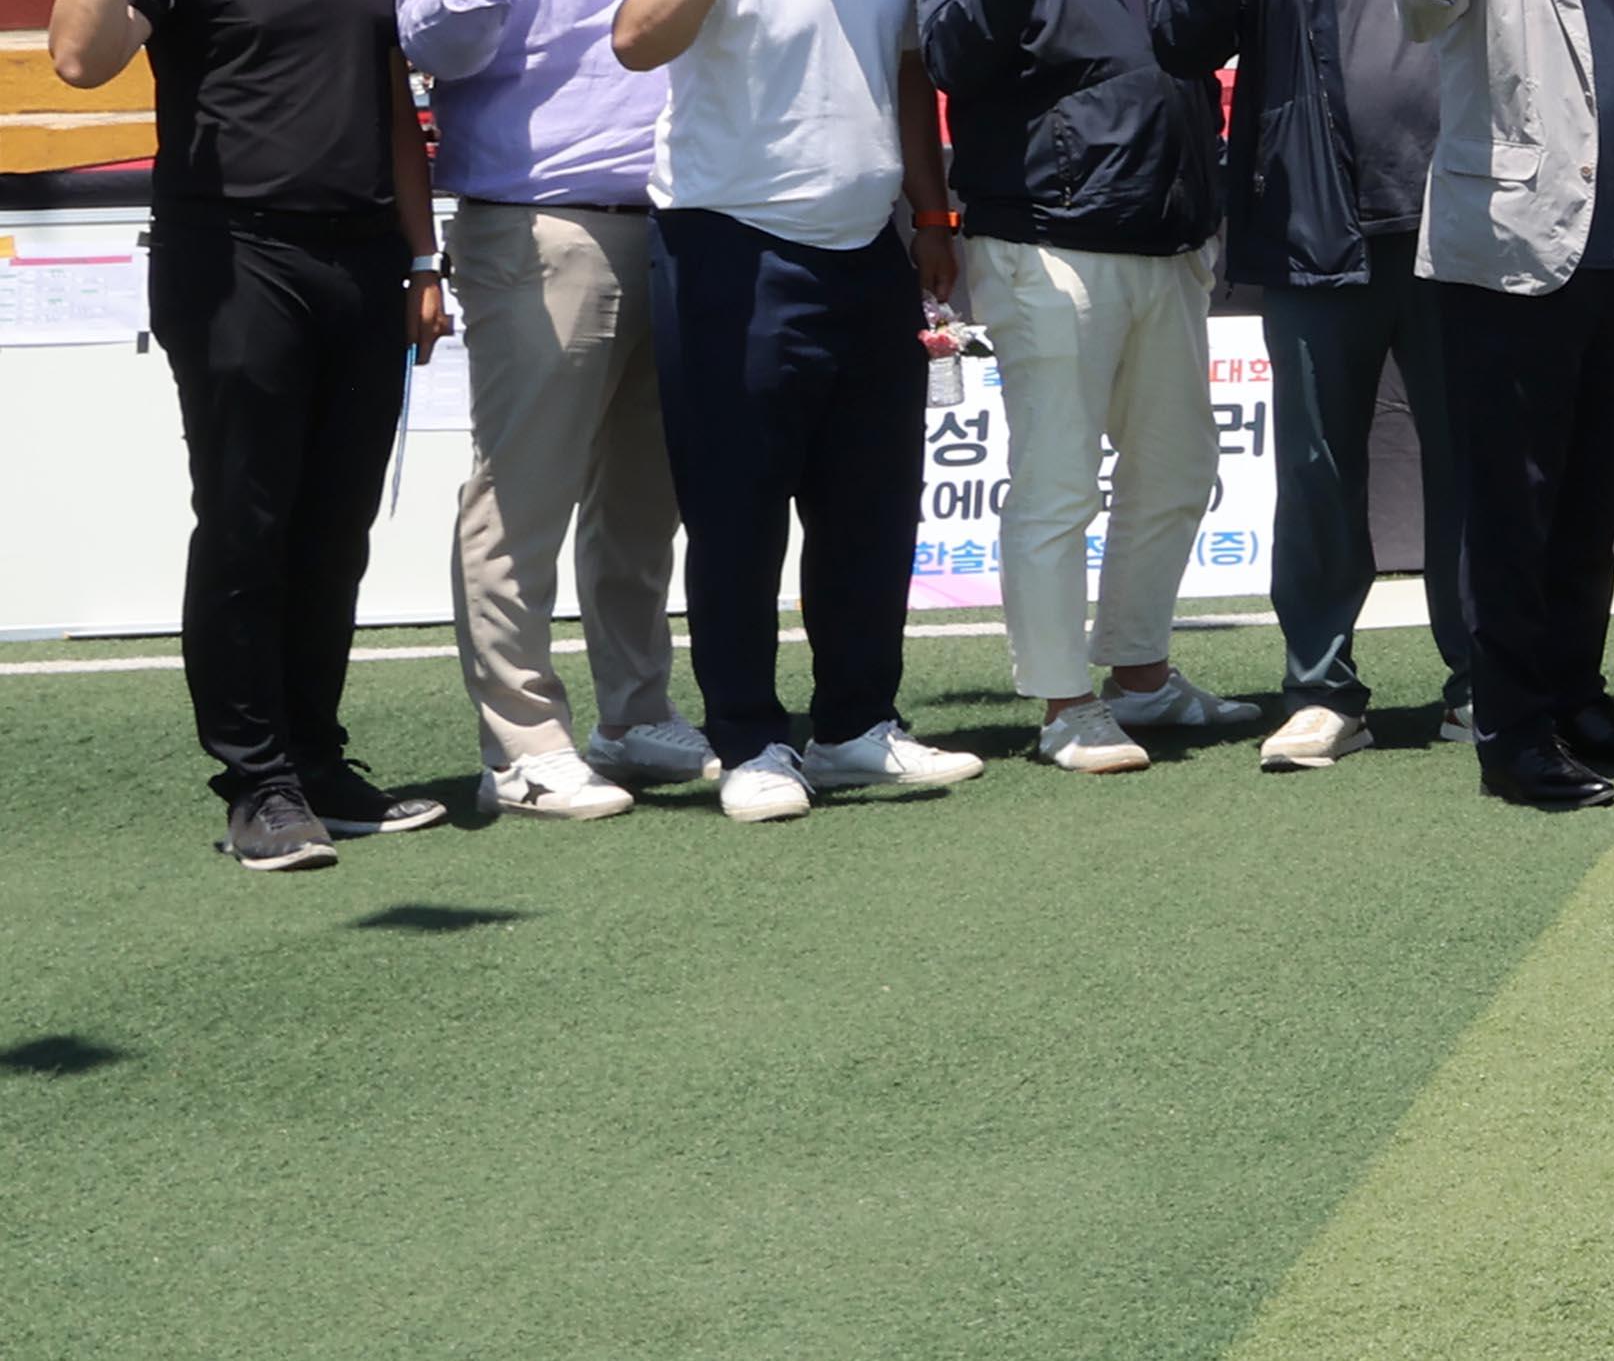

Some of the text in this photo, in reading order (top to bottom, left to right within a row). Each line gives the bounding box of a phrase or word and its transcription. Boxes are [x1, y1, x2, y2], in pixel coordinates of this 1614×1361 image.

[1209, 358, 1271, 384] 대회
[925, 409, 990, 468] 성
[912, 539, 1000, 577] 한솔
